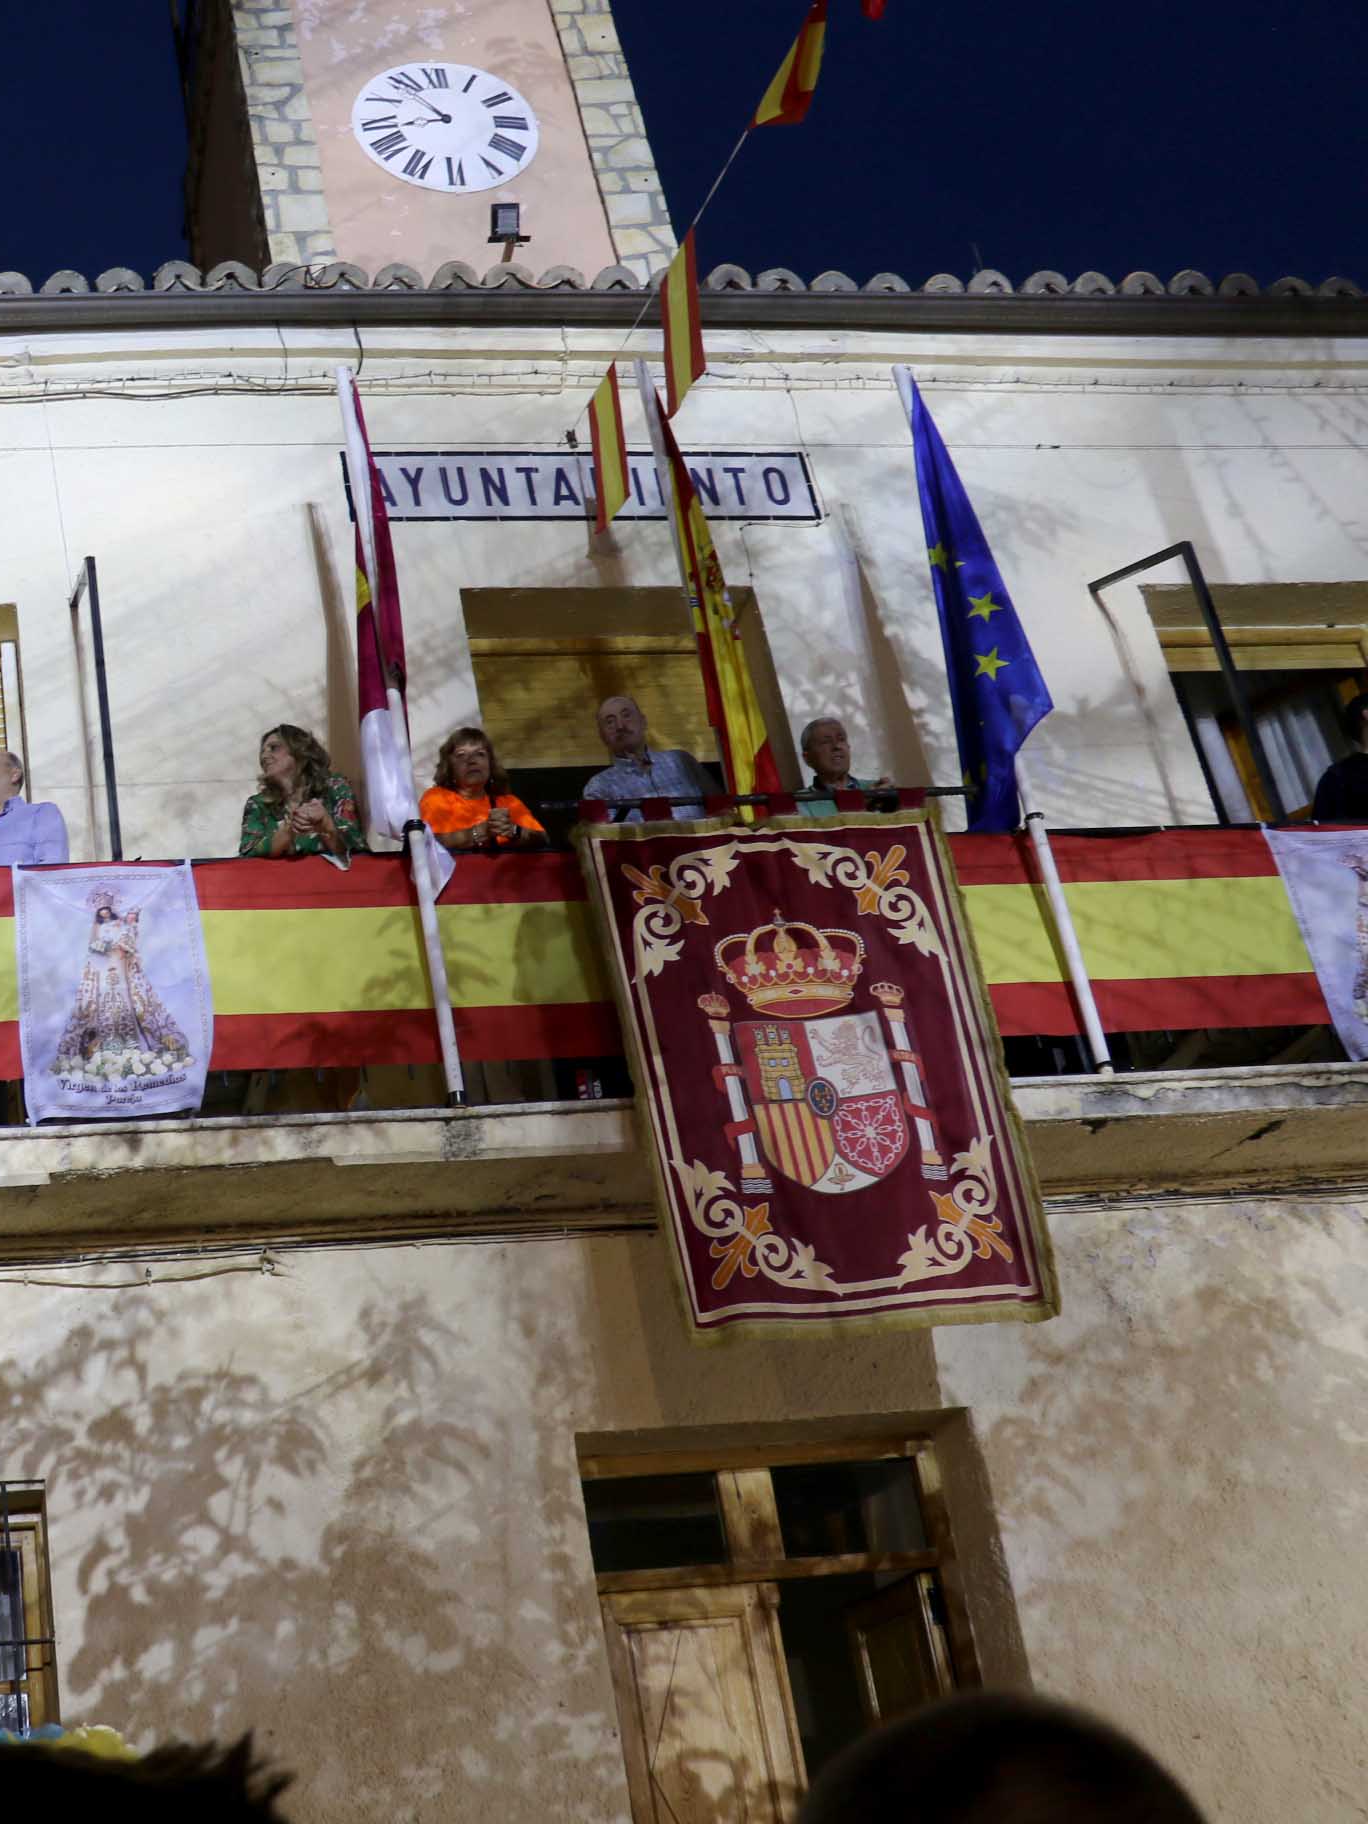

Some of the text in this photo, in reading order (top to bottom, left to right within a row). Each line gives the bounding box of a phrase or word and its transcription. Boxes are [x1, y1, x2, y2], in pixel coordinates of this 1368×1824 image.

[419, 67, 450, 89] XII
[462, 74, 478, 94] I
[365, 91, 403, 109] X
[482, 91, 515, 108] II
[492, 115, 529, 131] III
[477, 153, 504, 180] V
[375, 465, 791, 508] AYUNTAINTO
[58, 1078, 97, 1094] Virgen
